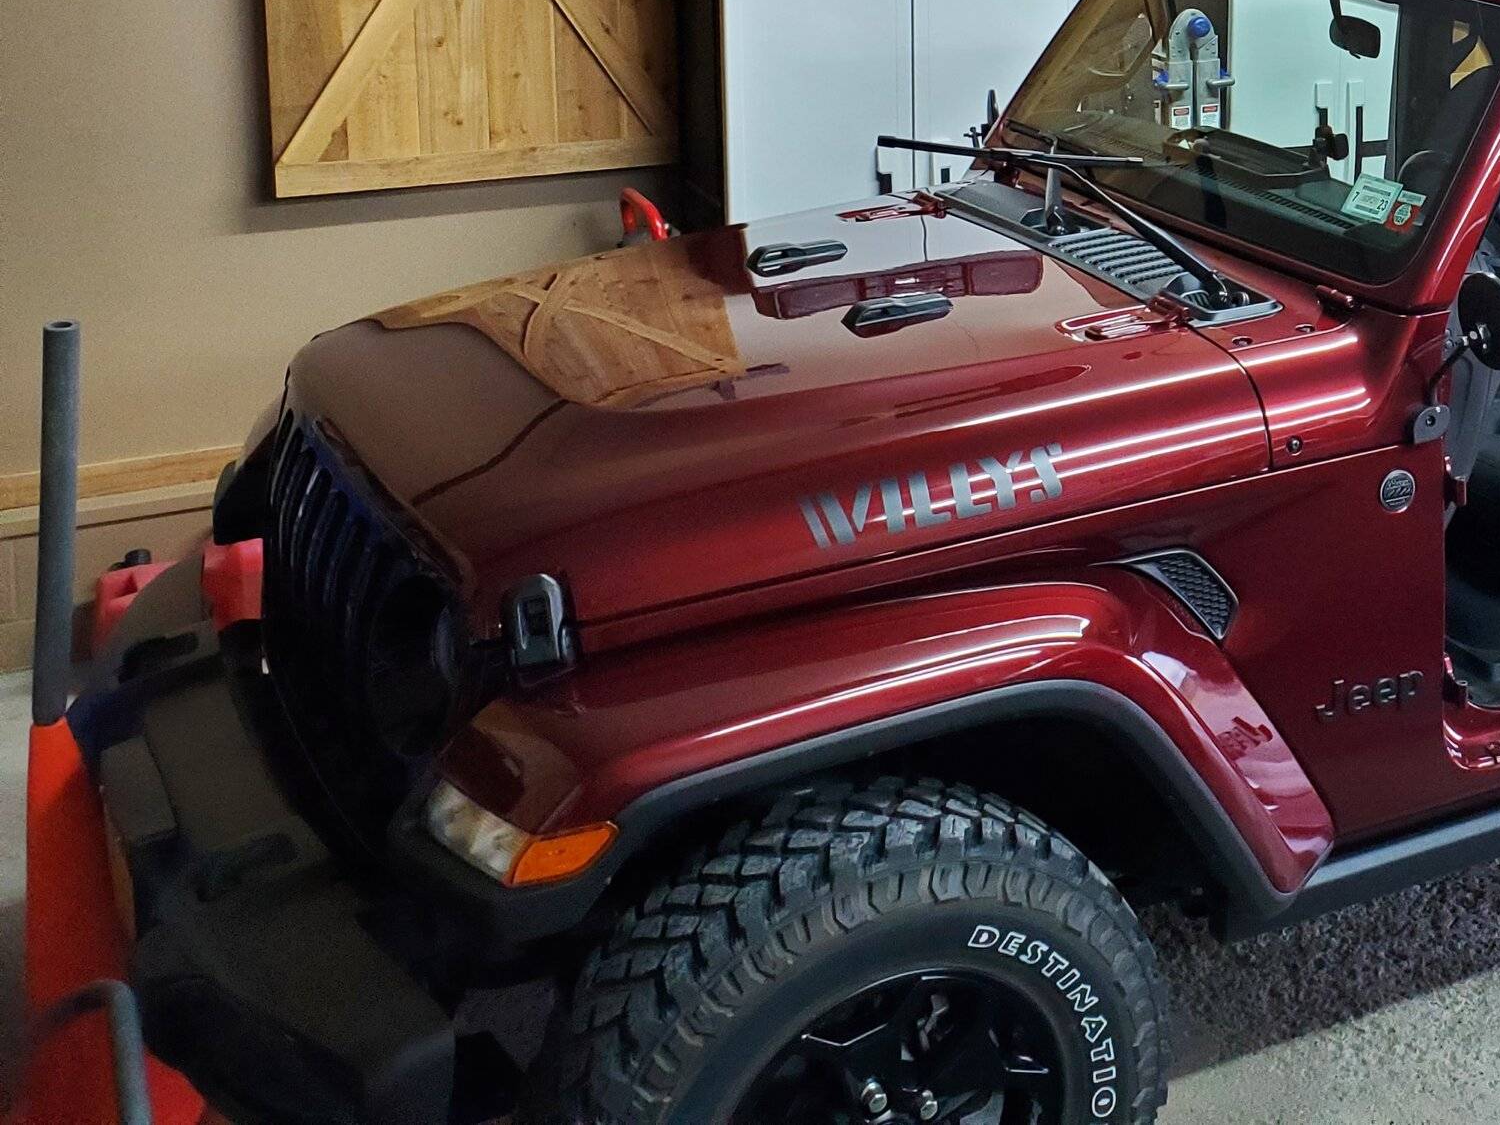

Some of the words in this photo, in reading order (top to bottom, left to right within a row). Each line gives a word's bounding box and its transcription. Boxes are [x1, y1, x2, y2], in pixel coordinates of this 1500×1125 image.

[799, 442, 1063, 550] WILLYS
[1315, 670, 1424, 724] Jeep
[967, 925, 1118, 1125] DESTINATIO
